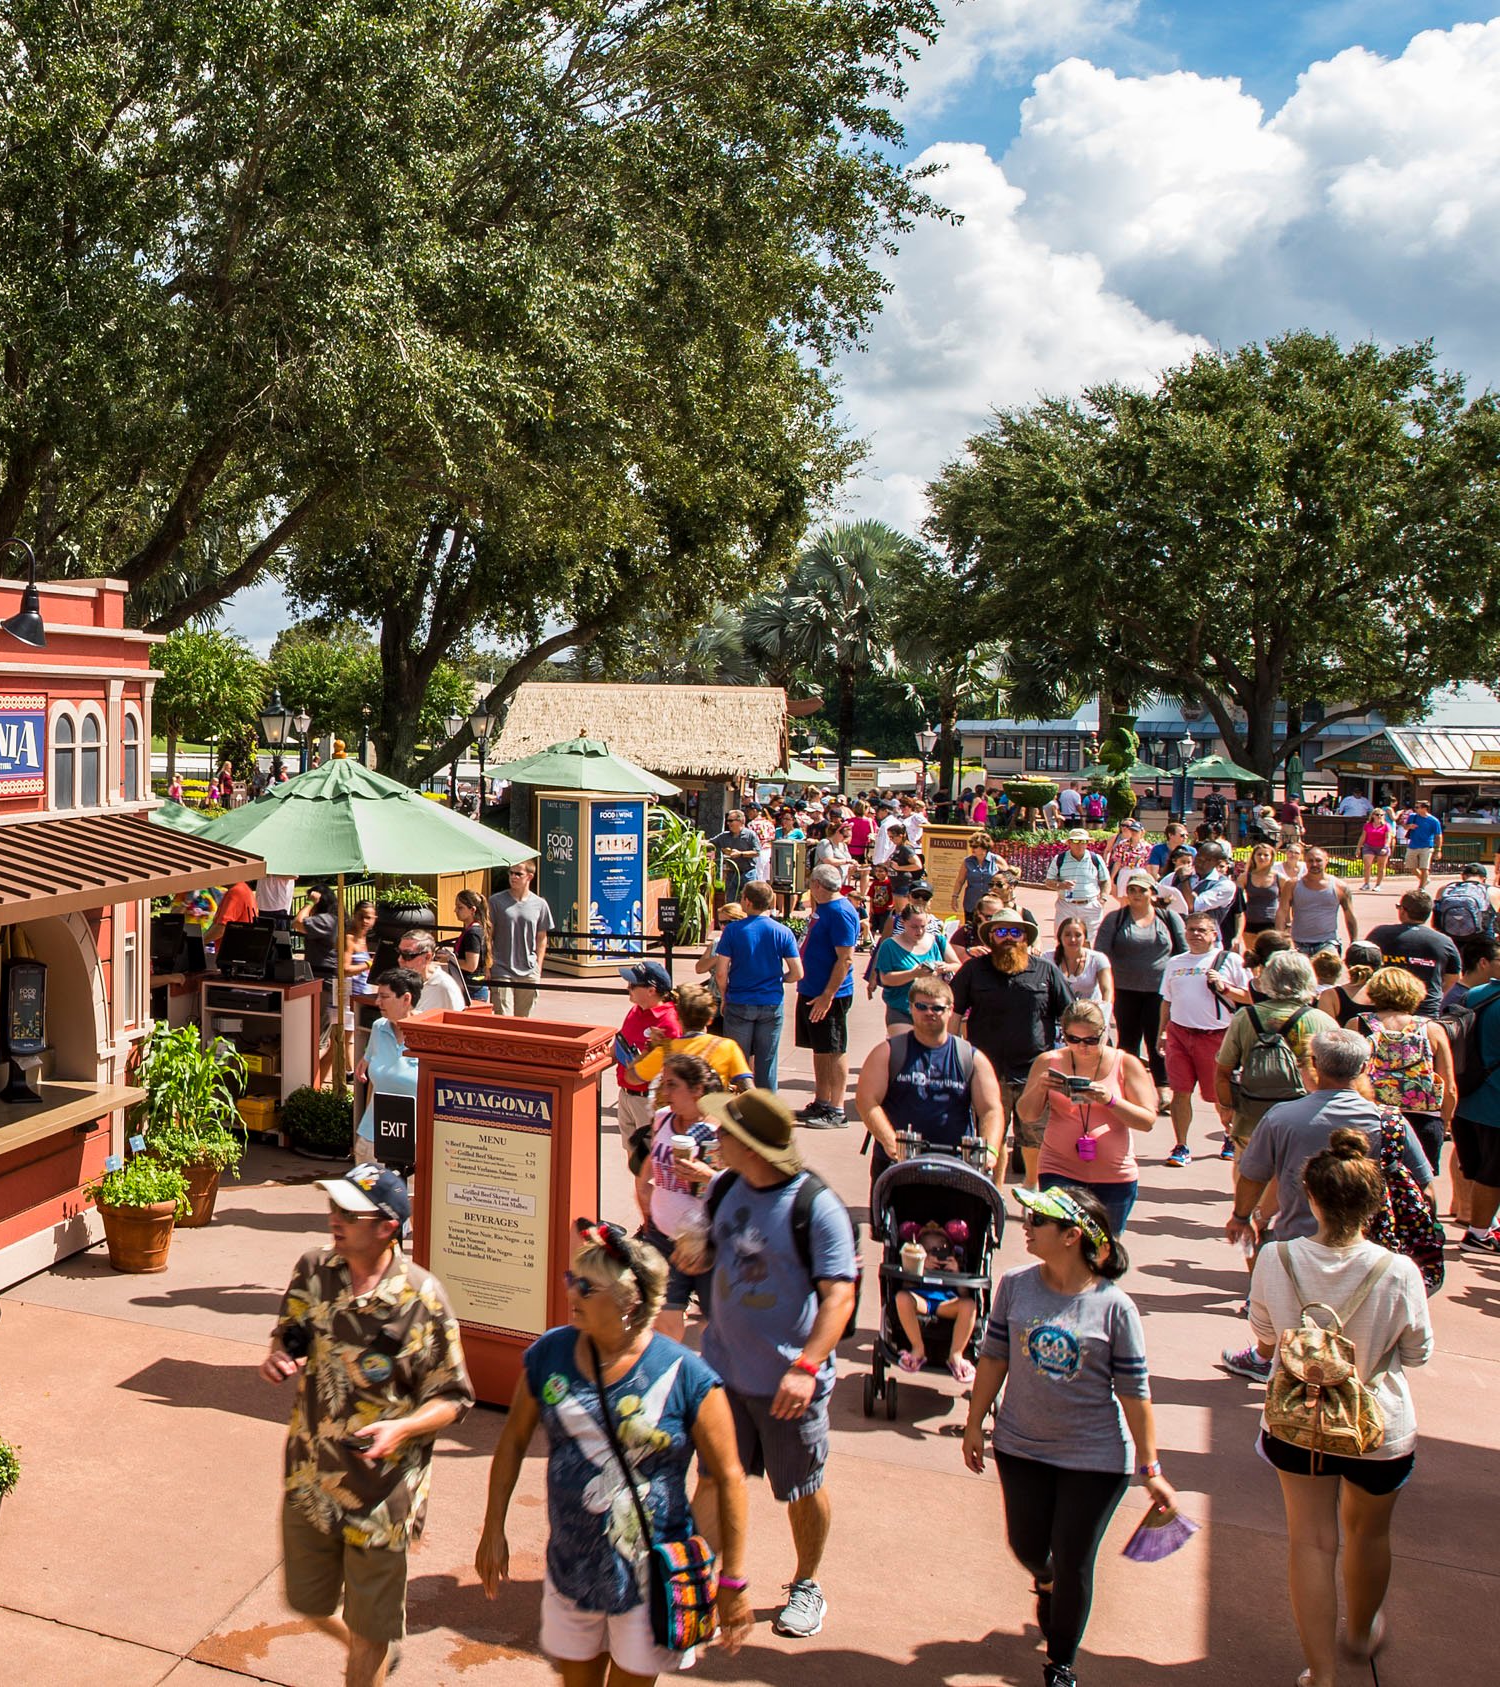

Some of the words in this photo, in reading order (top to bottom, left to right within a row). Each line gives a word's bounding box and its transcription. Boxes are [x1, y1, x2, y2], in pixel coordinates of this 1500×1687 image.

[600, 811, 616, 819] FOOD
[619, 811, 633, 819] WINE
[547, 833, 573, 848] FOOD
[553, 847, 573, 861] WINE
[437, 1089, 551, 1121] PATAGONIA
[381, 1120, 408, 1138] EXIT
[479, 1134, 507, 1146] MENU
[462, 1142, 488, 1152] Empanada
[457, 1150, 475, 1158] Grilled
[475, 1152, 486, 1160] Beef
[487, 1154, 505, 1162] Skewer
[457, 1162, 477, 1171] Roasted
[499, 1169, 518, 1177] Salmon
[462, 1188, 480, 1196] Grilled
[492, 1193, 510, 1201] Skewer
[454, 1193, 472, 1202] Bodega
[510, 1202, 528, 1210] Malbec
[464, 1212, 519, 1228] BEVERAGES
[448, 1234, 466, 1242] Bodega
[504, 1235, 520, 1244] Negro
[466, 1252, 485, 1260] Bottled
[486, 1246, 496, 1254] Rio
[496, 1248, 512, 1257] Negro
